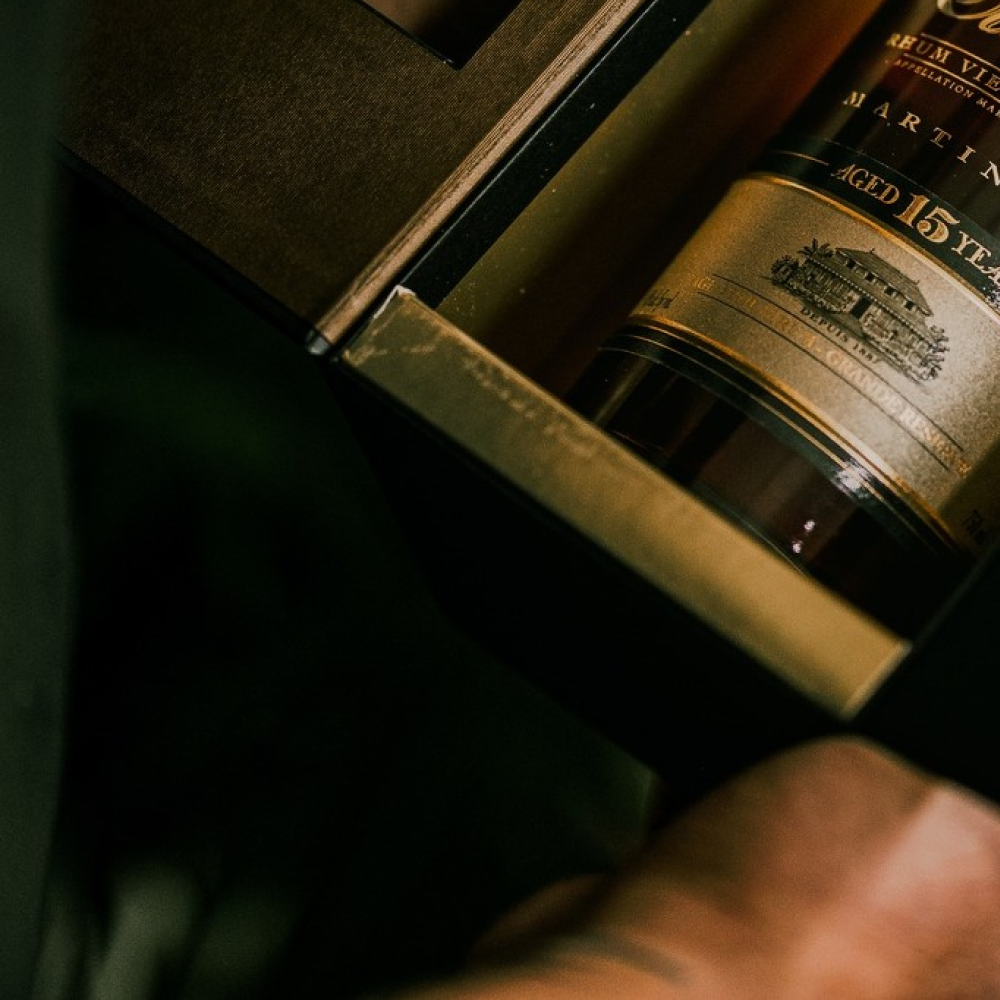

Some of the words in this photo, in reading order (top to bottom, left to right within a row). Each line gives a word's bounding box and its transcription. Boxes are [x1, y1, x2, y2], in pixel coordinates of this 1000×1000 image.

[887, 33, 950, 63] RHUM
[896, 58, 975, 102] APPELLATION
[831, 162, 901, 207] AGED
[892, 193, 961, 245] 15
[800, 306, 850, 345] DEPUIS
